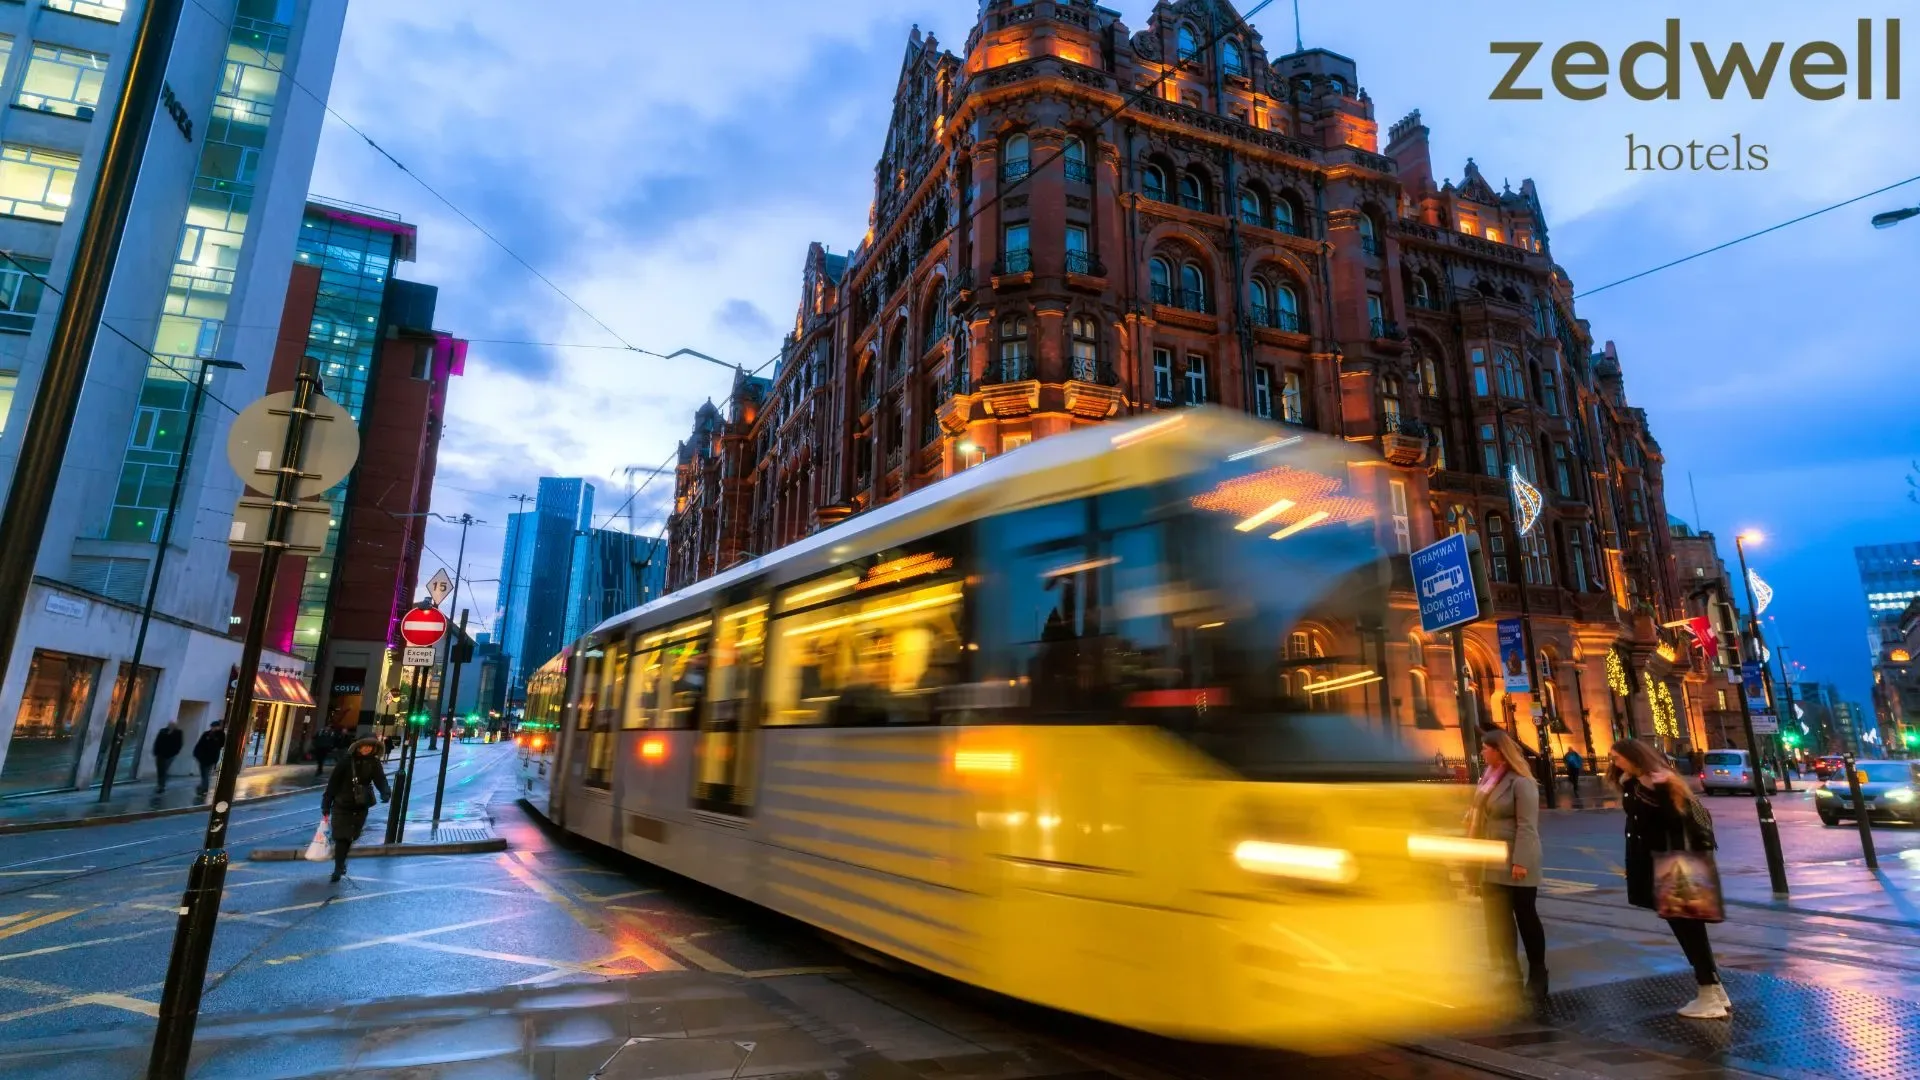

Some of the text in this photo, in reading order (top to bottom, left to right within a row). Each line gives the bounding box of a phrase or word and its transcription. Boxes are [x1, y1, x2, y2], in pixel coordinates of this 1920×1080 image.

[1417, 541, 1457, 566] TRAMWAY
[432, 581, 448, 592] 15
[1422, 589, 1471, 615] LOOK BOTH
[1436, 606, 1461, 623] WAYS
[407, 649, 432, 657] Except
